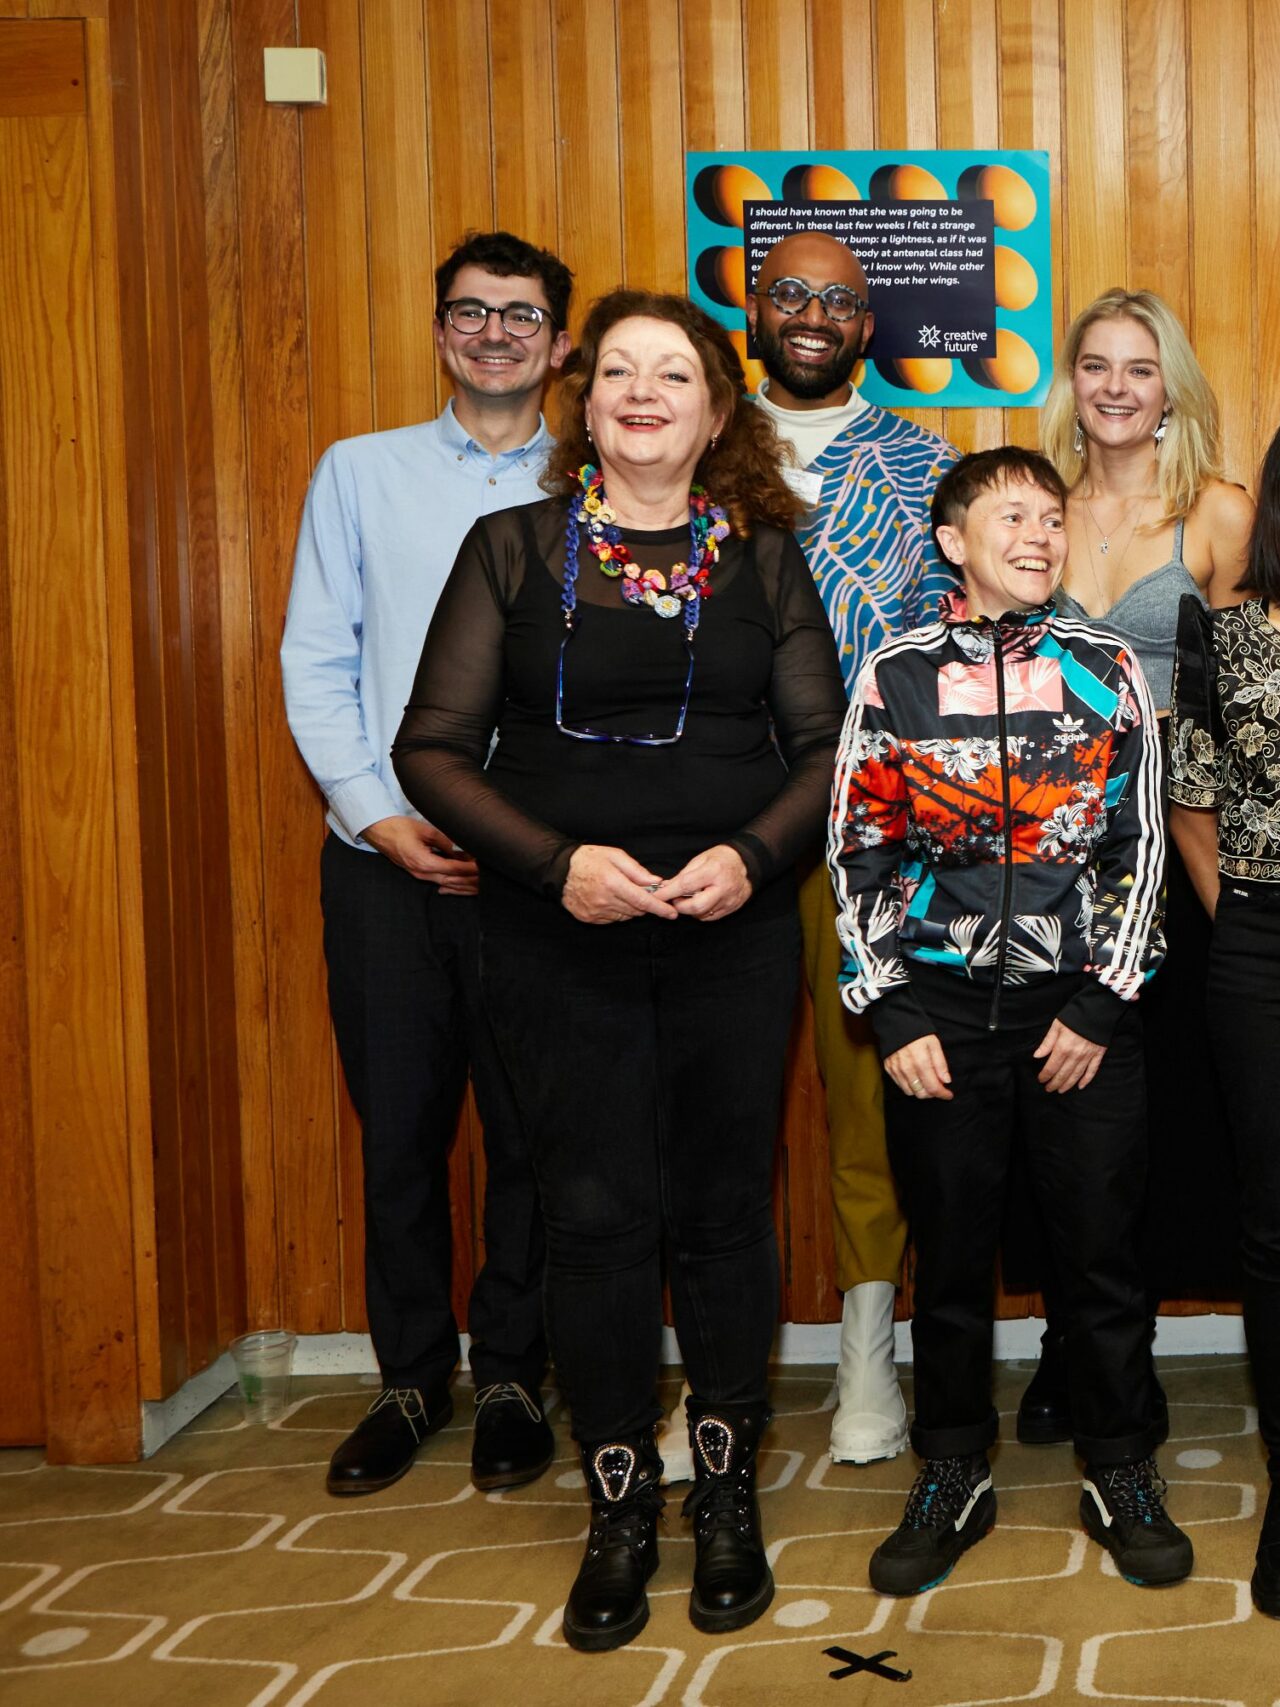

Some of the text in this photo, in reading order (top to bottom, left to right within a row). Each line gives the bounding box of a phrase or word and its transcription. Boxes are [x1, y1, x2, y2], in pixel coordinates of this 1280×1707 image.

[750, 207, 963, 217] I should have known that she was going to be
[750, 221, 793, 230] different.
[796, 221, 805, 230] In
[807, 221, 833, 230] these
[835, 221, 853, 230] last
[855, 221, 873, 230] few
[876, 221, 905, 230] weeks
[907, 221, 911, 230] I
[913, 221, 929, 230] felt
[940, 221, 975, 231] strange
[751, 235, 784, 243] sensati
[850, 235, 879, 245] bump:
[890, 235, 934, 245] lightness,
[950, 235, 957, 243] if
[958, 235, 965, 243] it
[881, 249, 891, 257] at
[893, 249, 937, 257] antenatal
[940, 249, 963, 257] class
[965, 249, 983, 257] had
[870, 262, 874, 271] I
[876, 262, 902, 271] know
[904, 262, 926, 272] why.
[930, 262, 957, 271] While
[959, 262, 985, 271] other
[866, 276, 960, 286] rying out her wings.
[944, 330, 988, 341] creative
[944, 341, 978, 352] future
